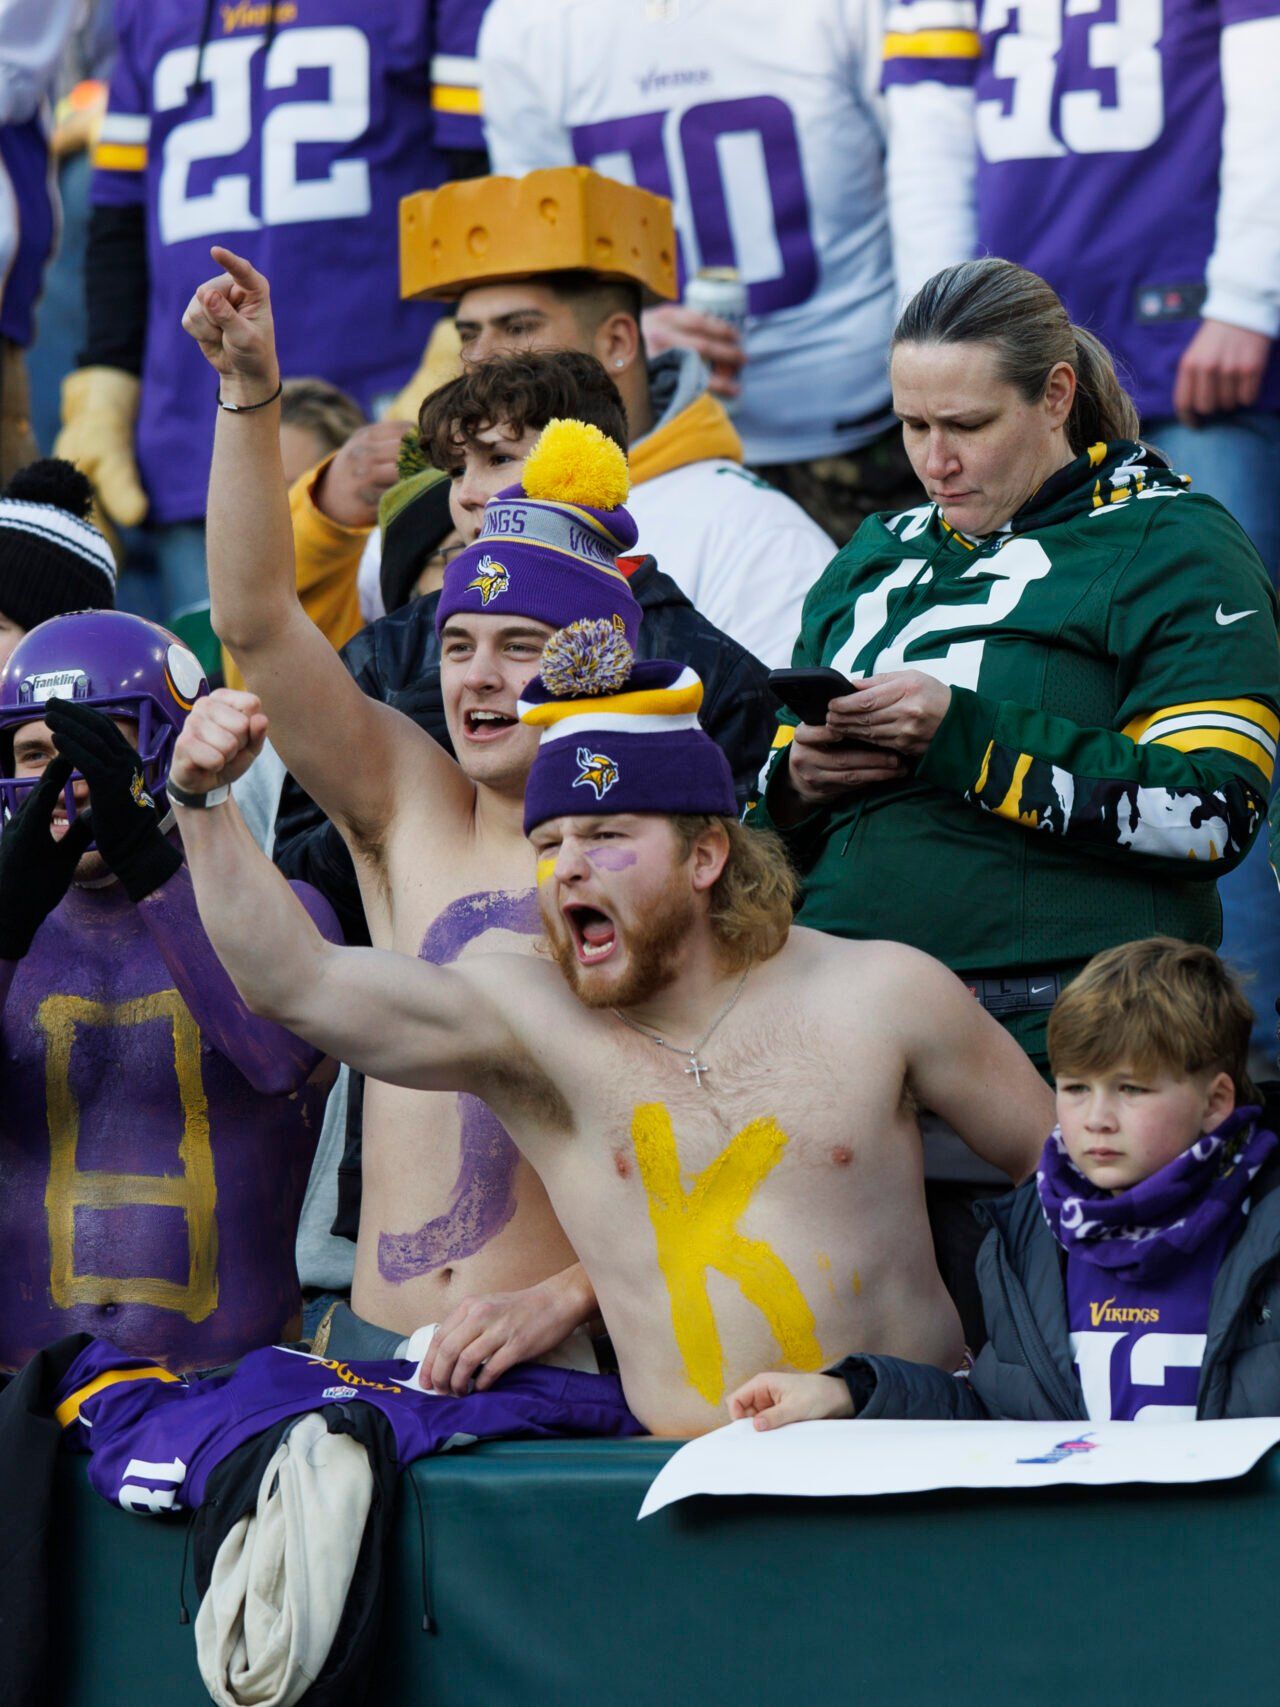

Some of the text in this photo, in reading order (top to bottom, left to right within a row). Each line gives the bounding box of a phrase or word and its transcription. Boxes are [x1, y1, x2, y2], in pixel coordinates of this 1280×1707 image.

[153, 25, 370, 246] 22
[831, 538, 1052, 692] 12
[631, 1101, 790, 1407] K
